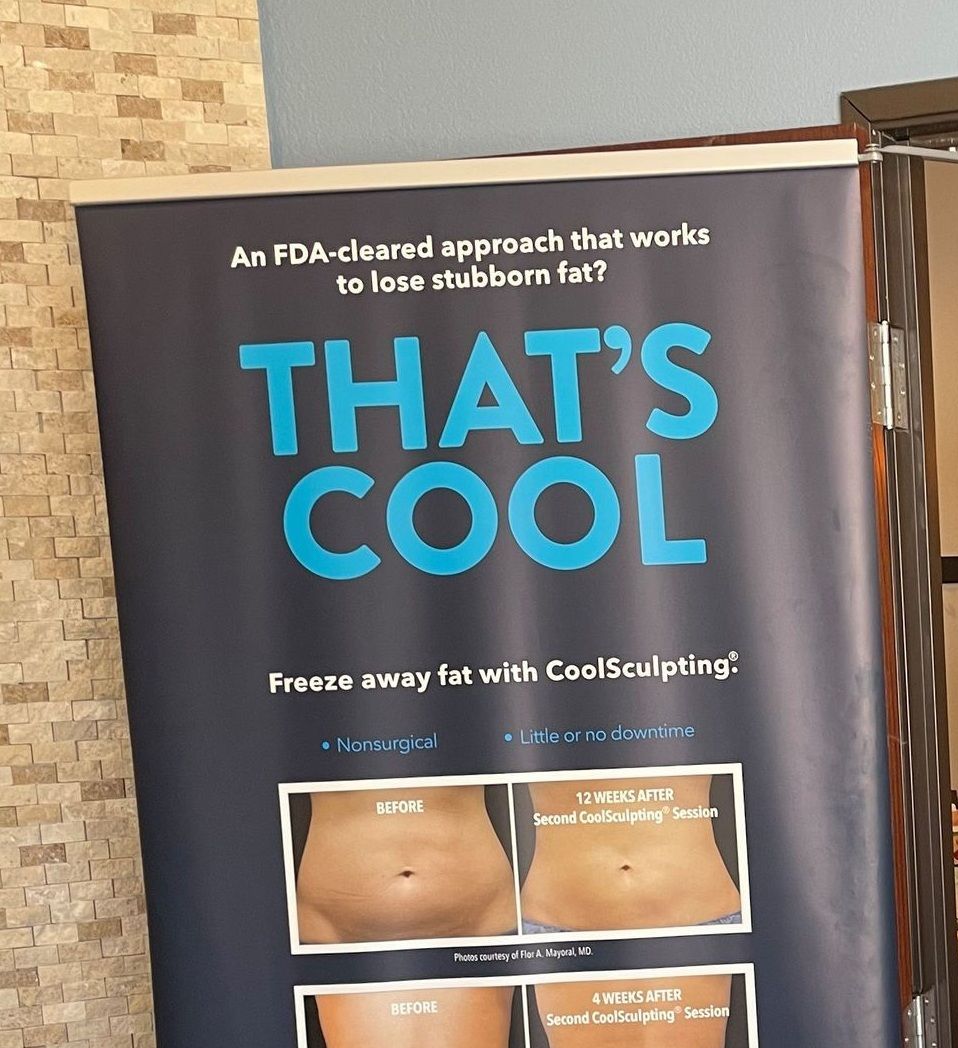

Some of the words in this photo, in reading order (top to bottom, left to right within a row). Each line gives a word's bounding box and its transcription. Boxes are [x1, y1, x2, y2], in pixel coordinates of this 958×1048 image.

[230, 245, 266, 268] An
[273, 235, 434, 266] FDA-cleared
[440, 229, 565, 262] approach
[570, 227, 624, 252] that
[629, 222, 710, 249] works
[336, 272, 364, 294] to
[370, 269, 425, 292] lose
[431, 263, 550, 290] stubborn
[556, 257, 607, 284] fat?
[239, 322, 719, 456] THAT'S
[283, 454, 708, 580] COOL
[268, 672, 353, 693] Freeze
[361, 670, 431, 693] away
[436, 663, 473, 685] fat
[478, 661, 538, 685] with
[336, 732, 437, 754] Nonsurgical
[520, 726, 560, 745] Little
[563, 730, 581, 742] or
[585, 728, 608, 741] no
[610, 723, 694, 741] downtime
[376, 799, 424, 814] BEFORE
[576, 790, 591, 805] 12
[593, 789, 636, 803] WEEKS
[637, 787, 674, 801] AFTER
[533, 809, 576, 826] Second
[672, 805, 719, 820] Session
[453, 952, 478, 961] Photos
[479, 952, 510, 962] courtesy
[510, 949, 519, 959] of
[520, 949, 534, 958] Flor
[535, 949, 543, 957] A.
[592, 992, 601, 1004] 4
[602, 990, 644, 1004] WEEKS
[645, 988, 681, 1002] AFTER
[390, 1000, 438, 1015] BEFORE
[546, 1011, 590, 1026] Second
[684, 1004, 729, 1019] Session
